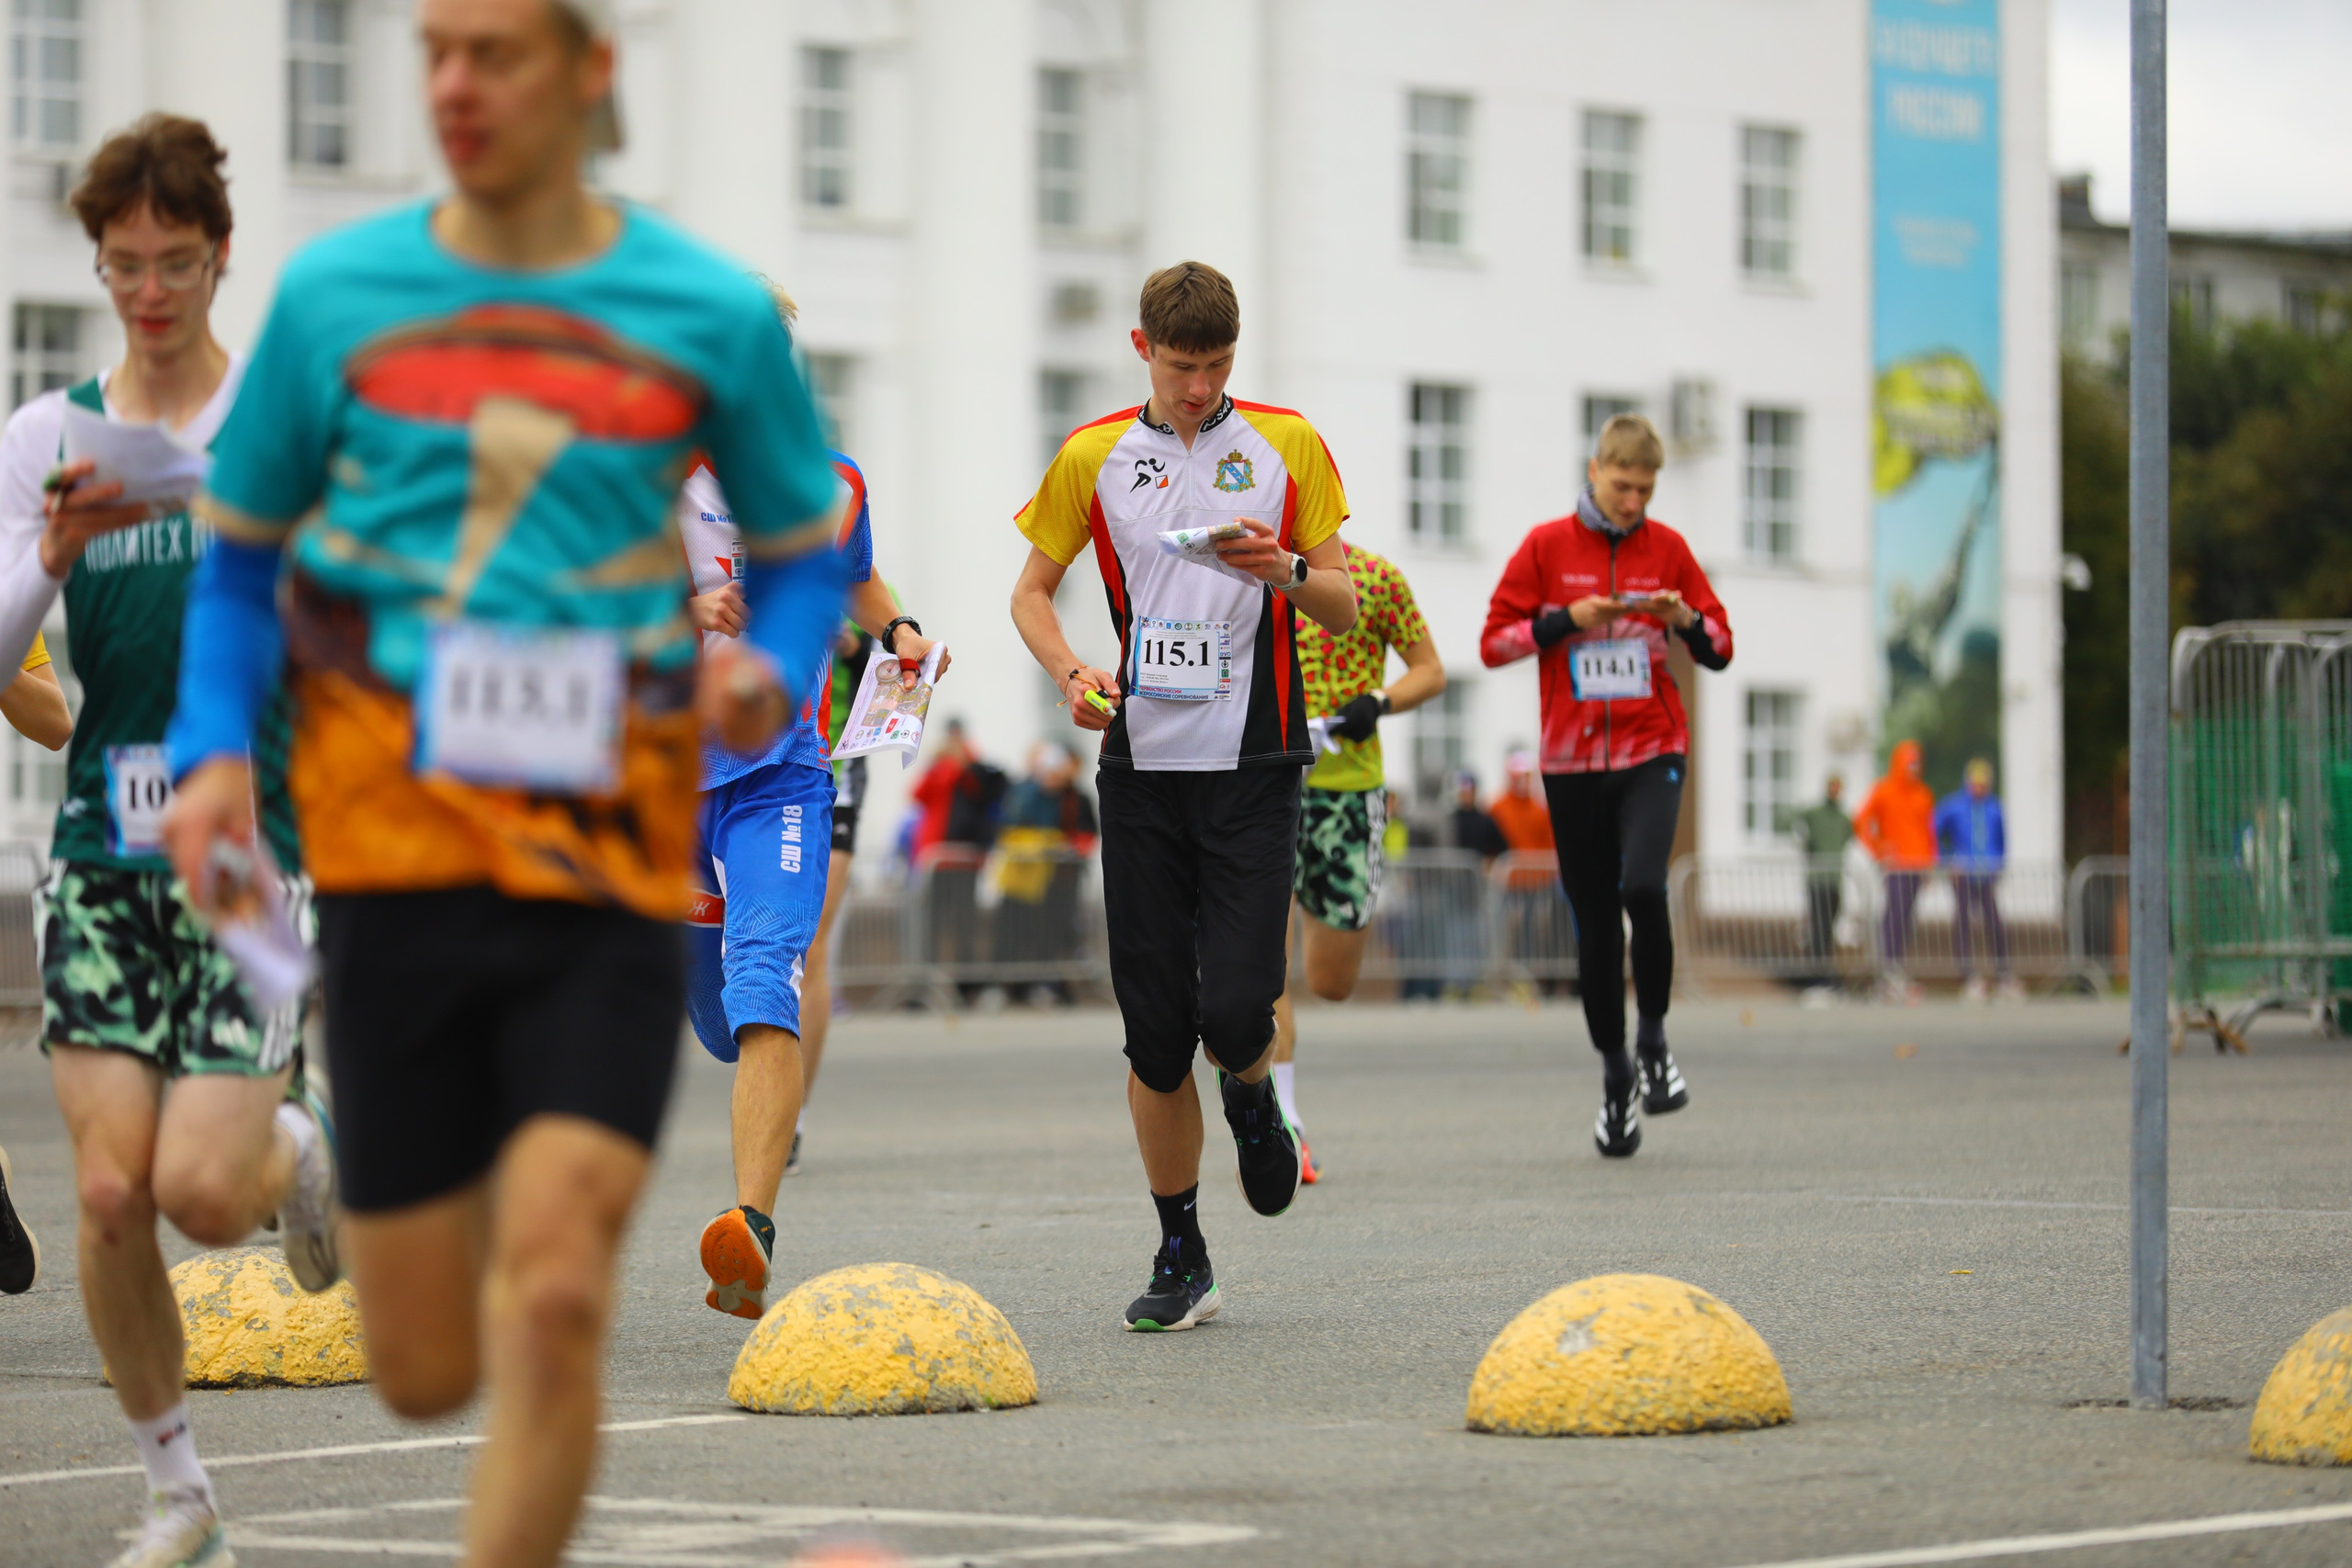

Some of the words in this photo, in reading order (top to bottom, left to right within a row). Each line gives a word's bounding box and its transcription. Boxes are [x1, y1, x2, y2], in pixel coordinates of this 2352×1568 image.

[701, 512, 716, 522] СШ
[1143, 638, 1211, 667] 115.1
[1583, 655, 1635, 678] 114.1
[781, 805, 803, 842] №18
[781, 845, 801, 874] СШ
